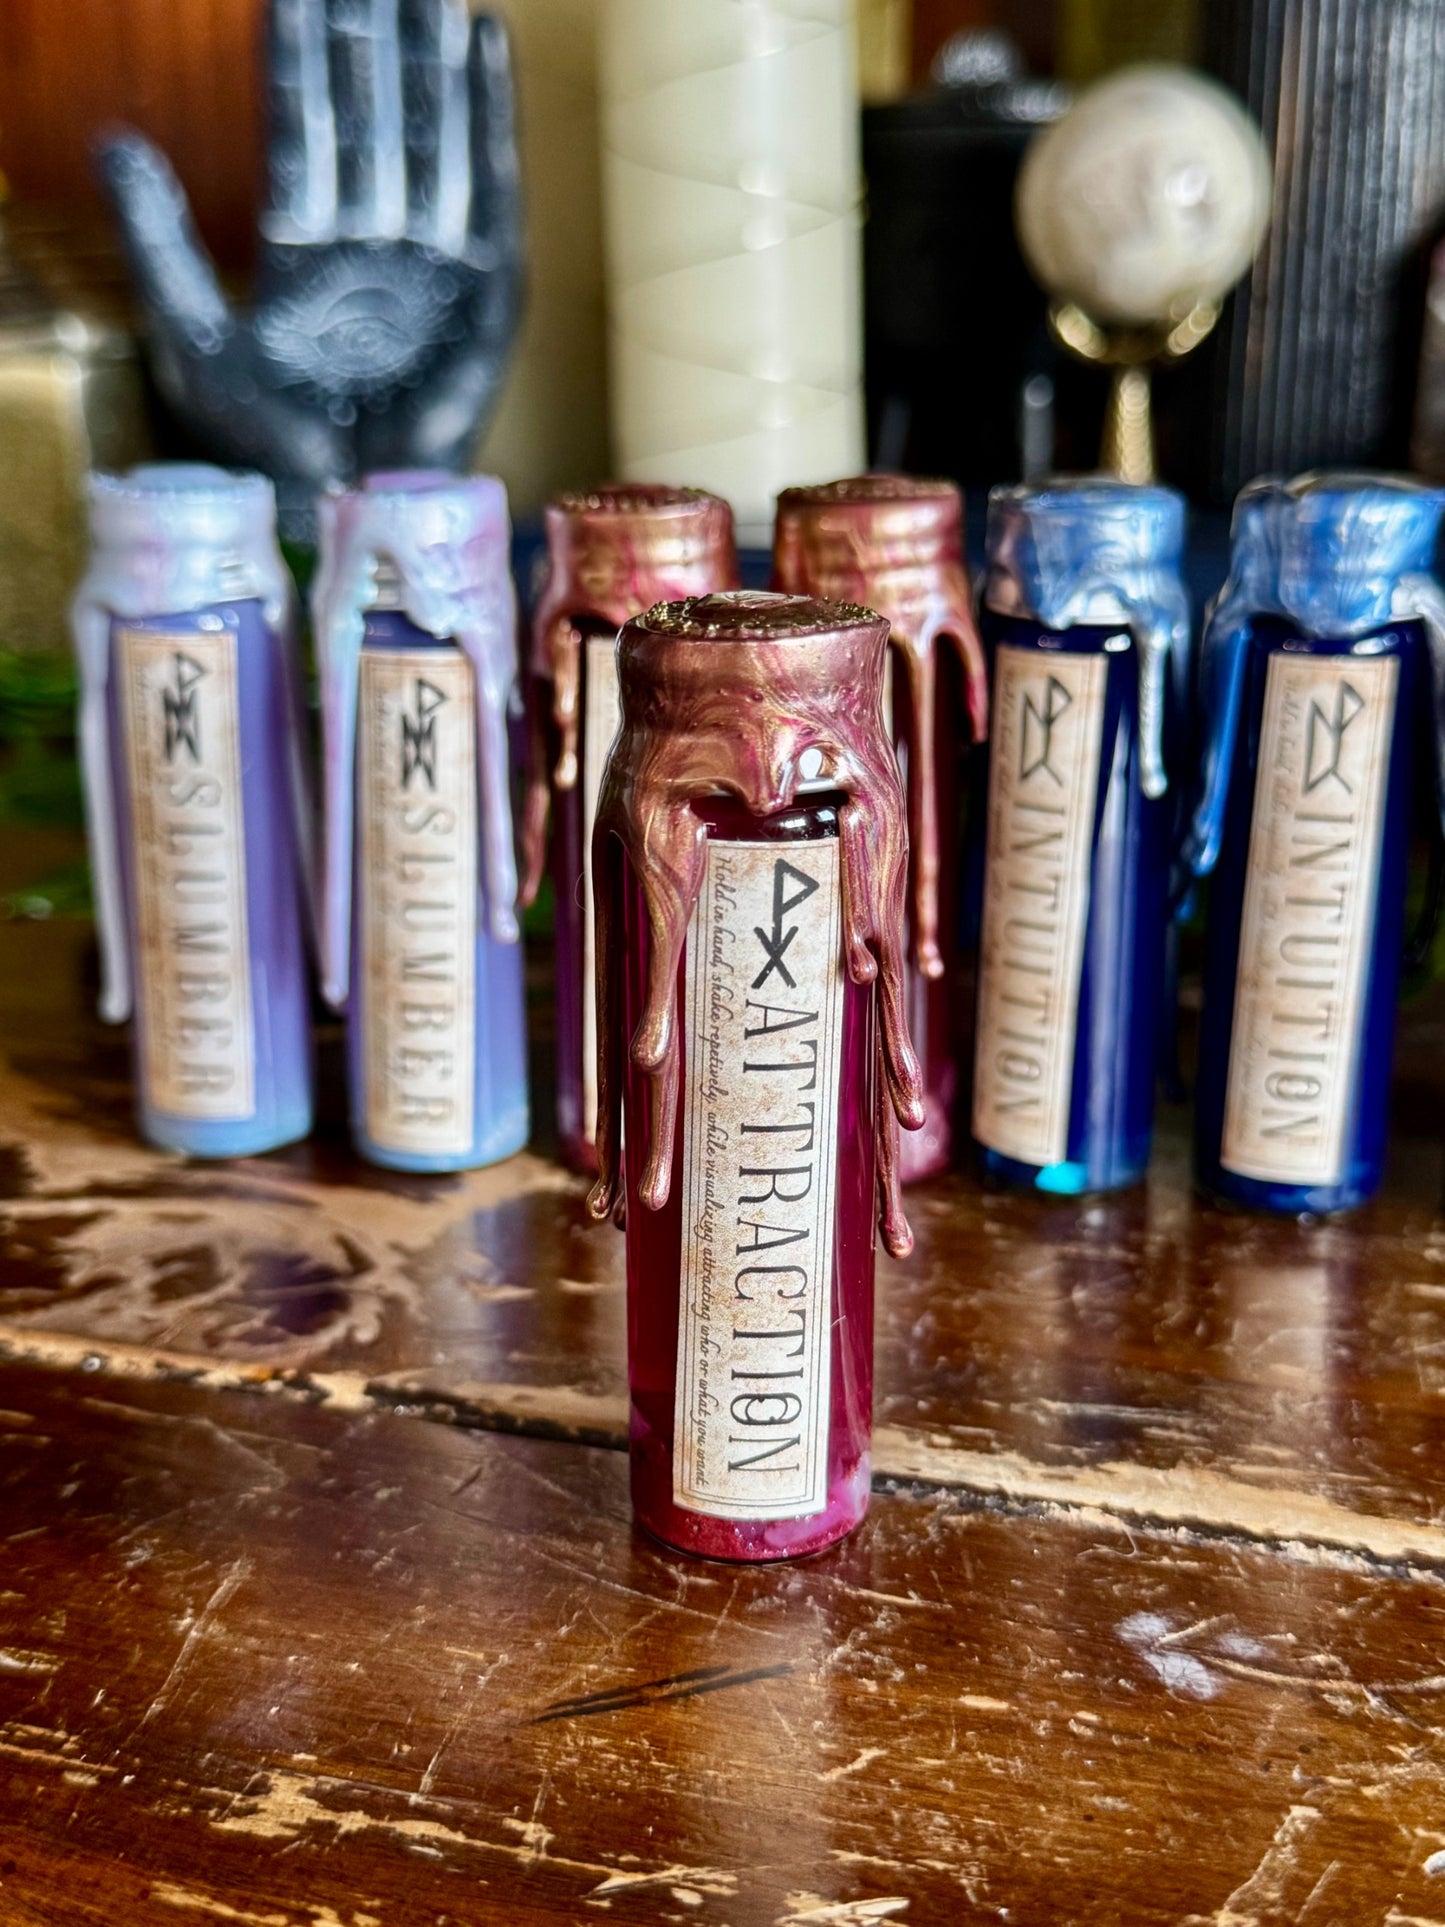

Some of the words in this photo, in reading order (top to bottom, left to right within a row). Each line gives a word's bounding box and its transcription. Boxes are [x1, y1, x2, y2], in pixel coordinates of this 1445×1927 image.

[714, 856, 736, 909] Hold
[713, 905, 728, 924] in
[400, 804, 456, 1124] SLUMBER
[709, 926, 736, 975] hand,
[994, 801, 1065, 1124] INTUITION
[710, 974, 735, 1023] shake
[1258, 811, 1354, 1141] INTUITION
[705, 1112, 728, 1157] while
[693, 1160, 725, 1244] visualizing
[727, 998, 819, 1473] ATTRACTION
[691, 1246, 717, 1321] attracting
[699, 1324, 721, 1358] who
[699, 1358, 711, 1378] or
[698, 1378, 719, 1418] what
[690, 1410, 707, 1446] you
